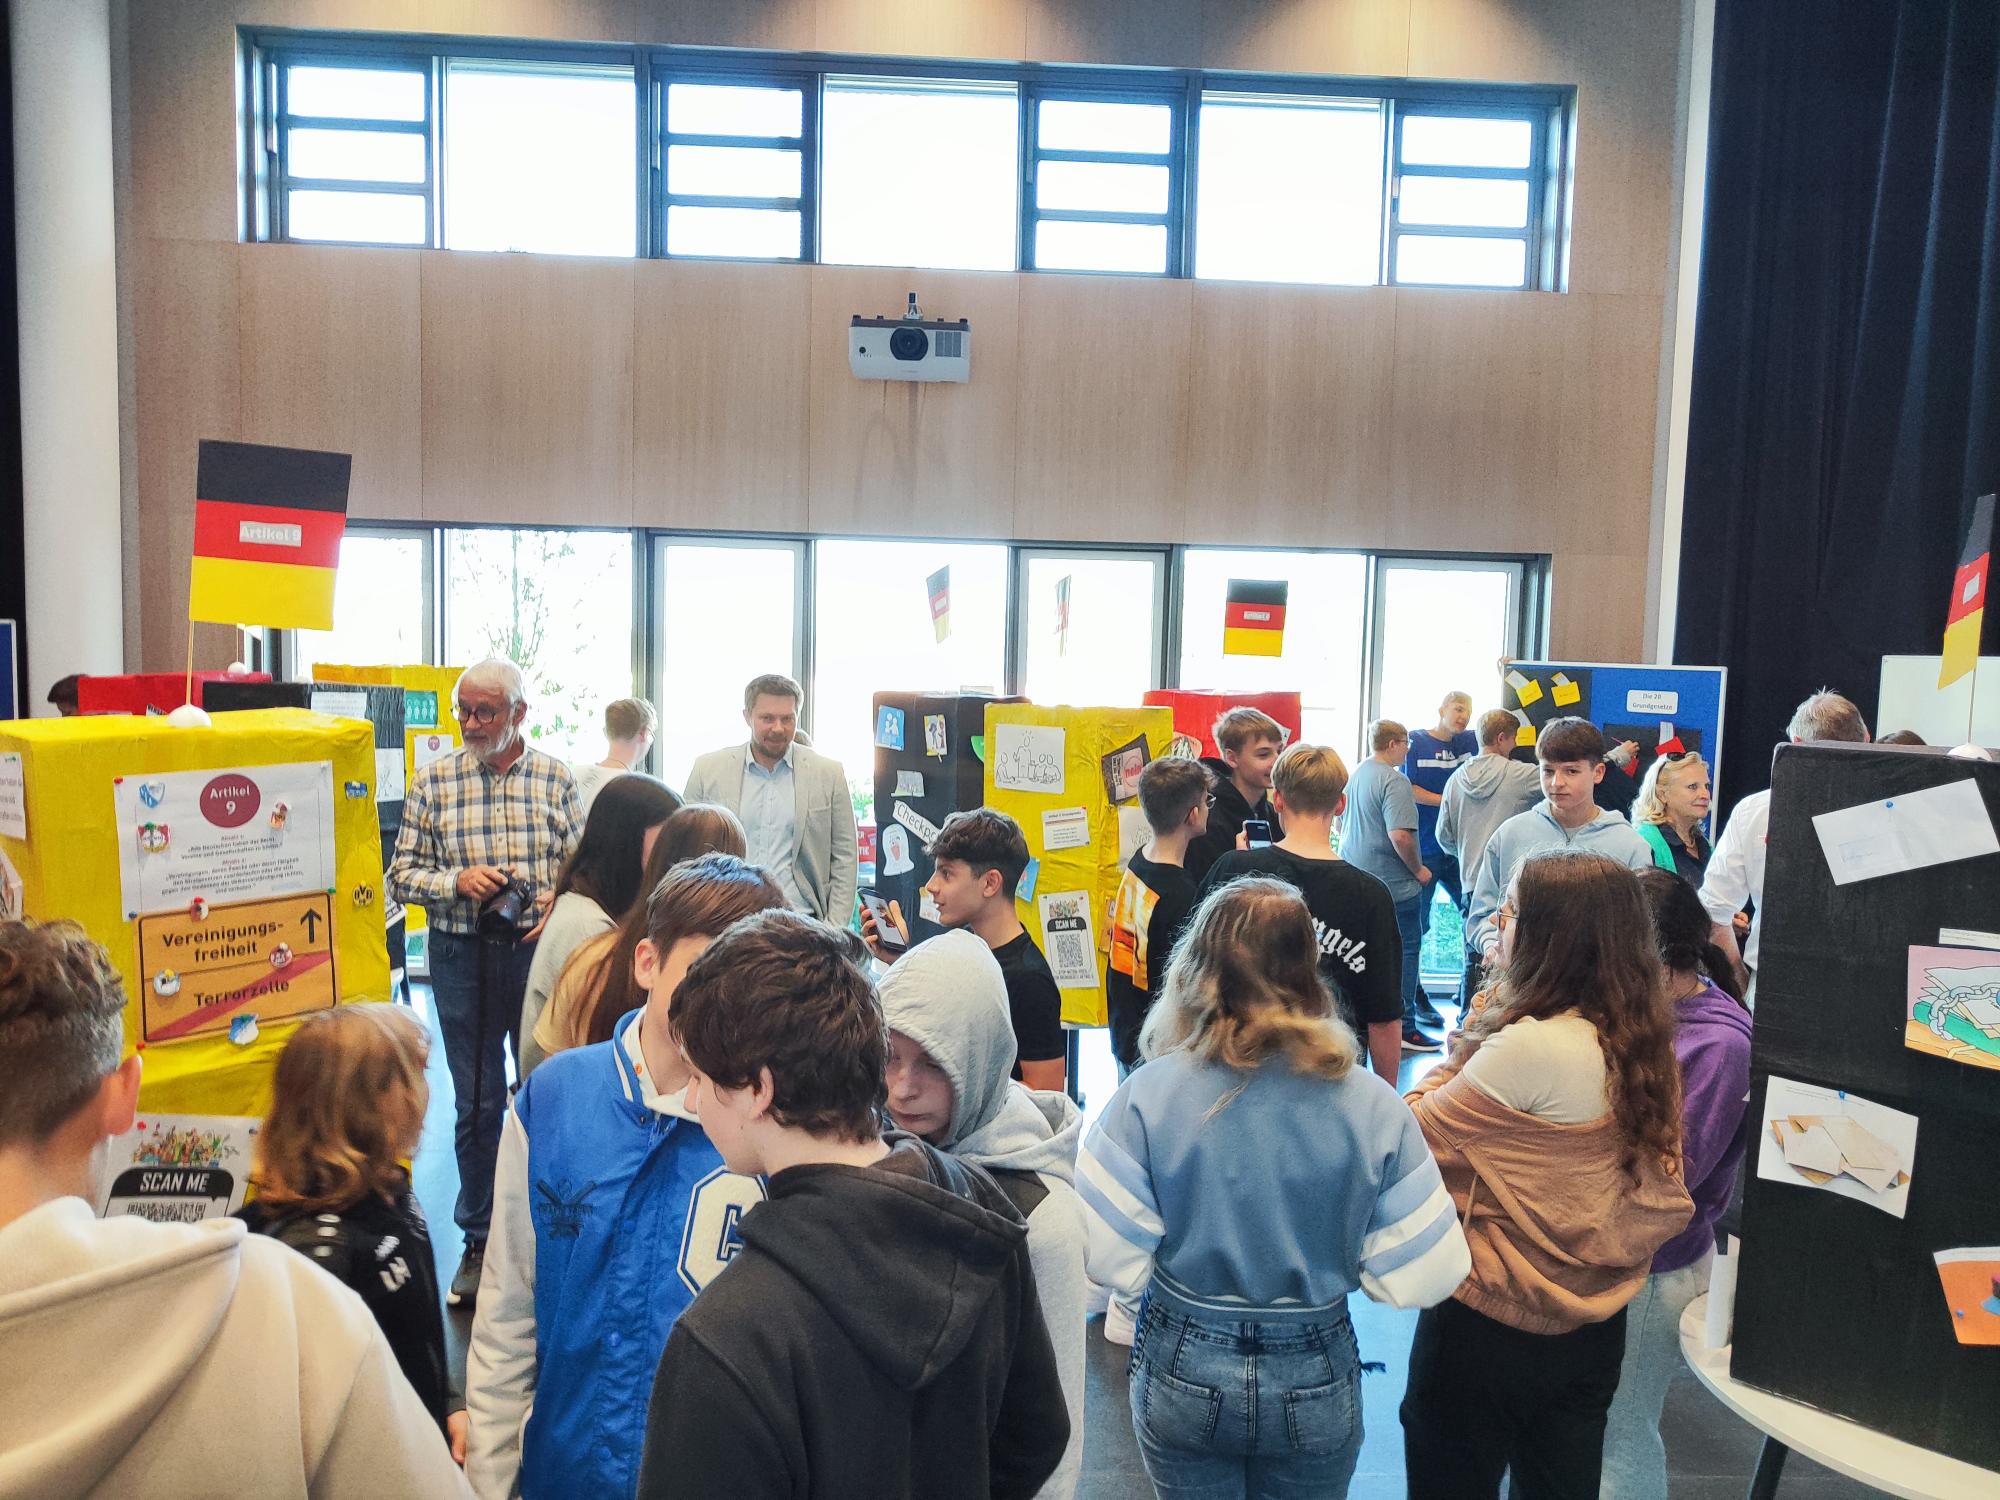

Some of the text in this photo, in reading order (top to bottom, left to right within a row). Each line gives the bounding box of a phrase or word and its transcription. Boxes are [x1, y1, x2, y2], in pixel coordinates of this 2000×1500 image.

[240, 526, 289, 541] Artikel
[210, 785, 250, 799] Artikel
[225, 801, 237, 815] 9
[162, 920, 284, 948] Vereinigungs-
[194, 941, 258, 963] freiheit
[194, 980, 290, 1008] Terrorzelle
[140, 1171, 210, 1193] SCAN ME
